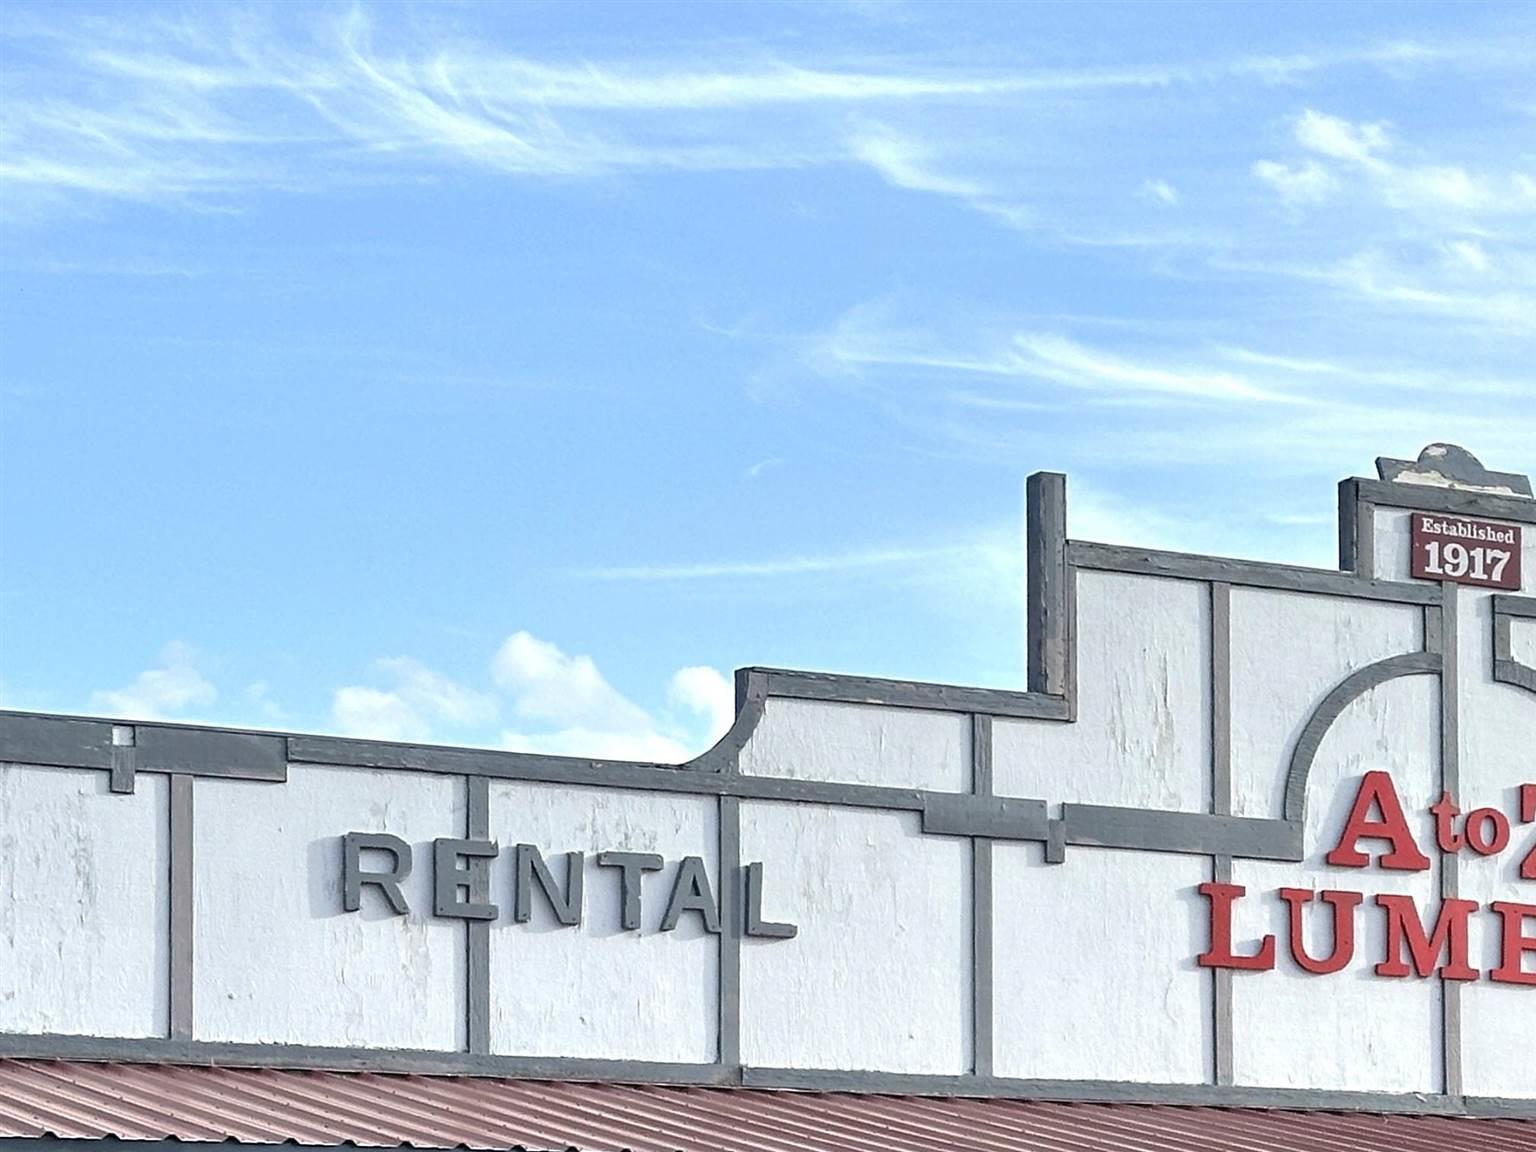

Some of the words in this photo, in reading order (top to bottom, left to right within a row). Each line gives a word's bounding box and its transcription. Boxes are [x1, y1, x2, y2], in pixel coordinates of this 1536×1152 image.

[1421, 517, 1515, 544] Established
[1424, 541, 1511, 582] 1917
[342, 831, 798, 939] RENTAL
